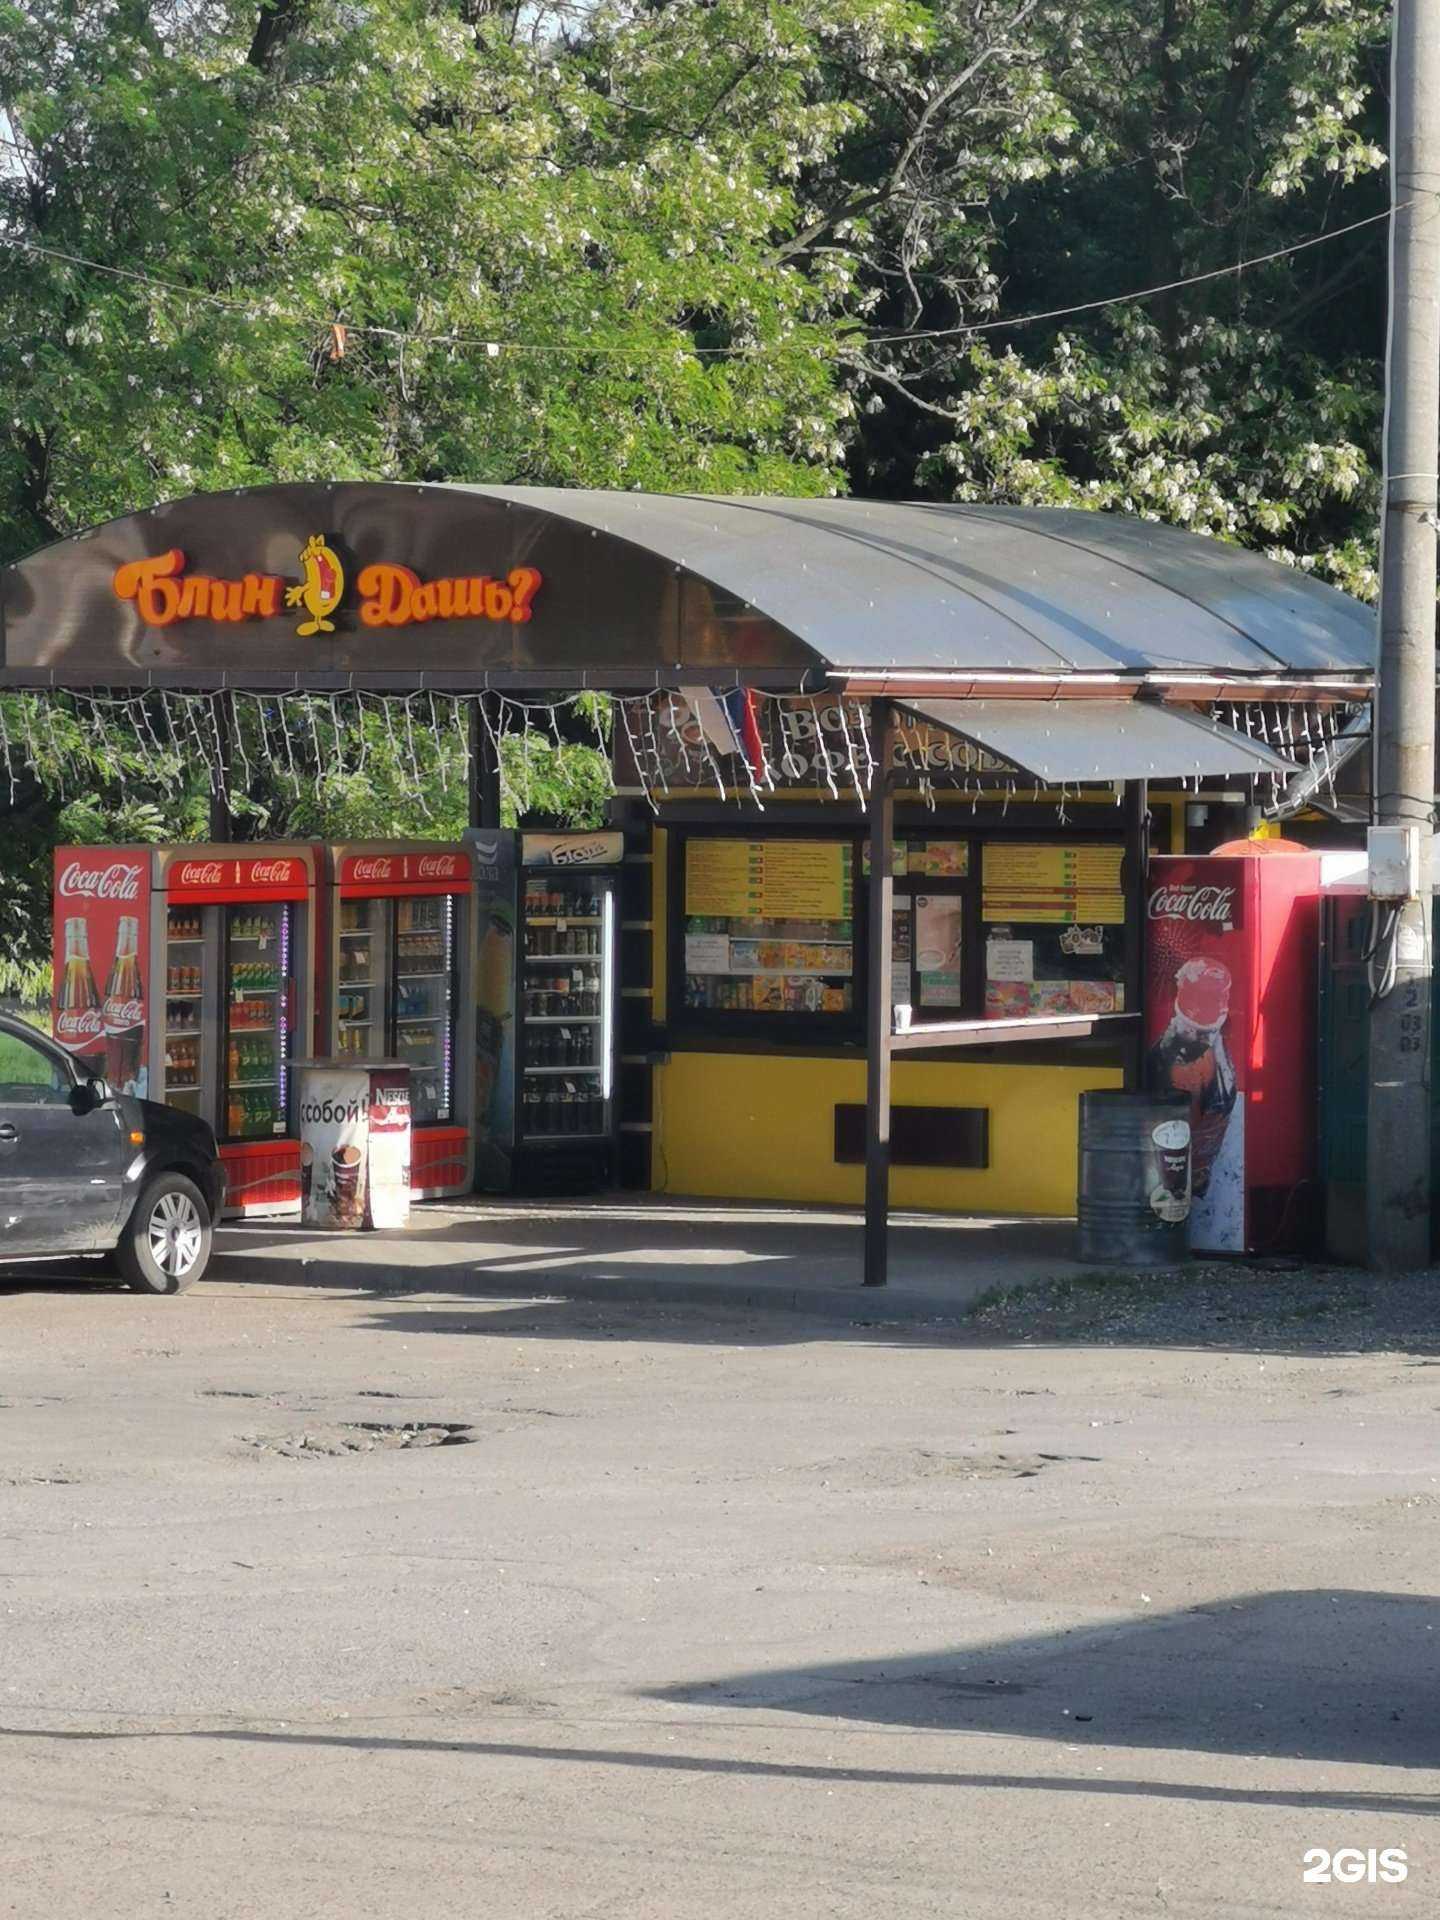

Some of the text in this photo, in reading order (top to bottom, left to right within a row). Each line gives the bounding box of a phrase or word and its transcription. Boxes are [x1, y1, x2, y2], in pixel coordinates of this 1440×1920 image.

[113, 549, 542, 627] Блин Дашь?
[60, 862, 144, 900] Coca-Cola
[181, 860, 291, 884] Coca-Cola Coca-Cola
[353, 856, 392, 880] Coca-Cola
[1147, 886, 1237, 920] Coca-Cola
